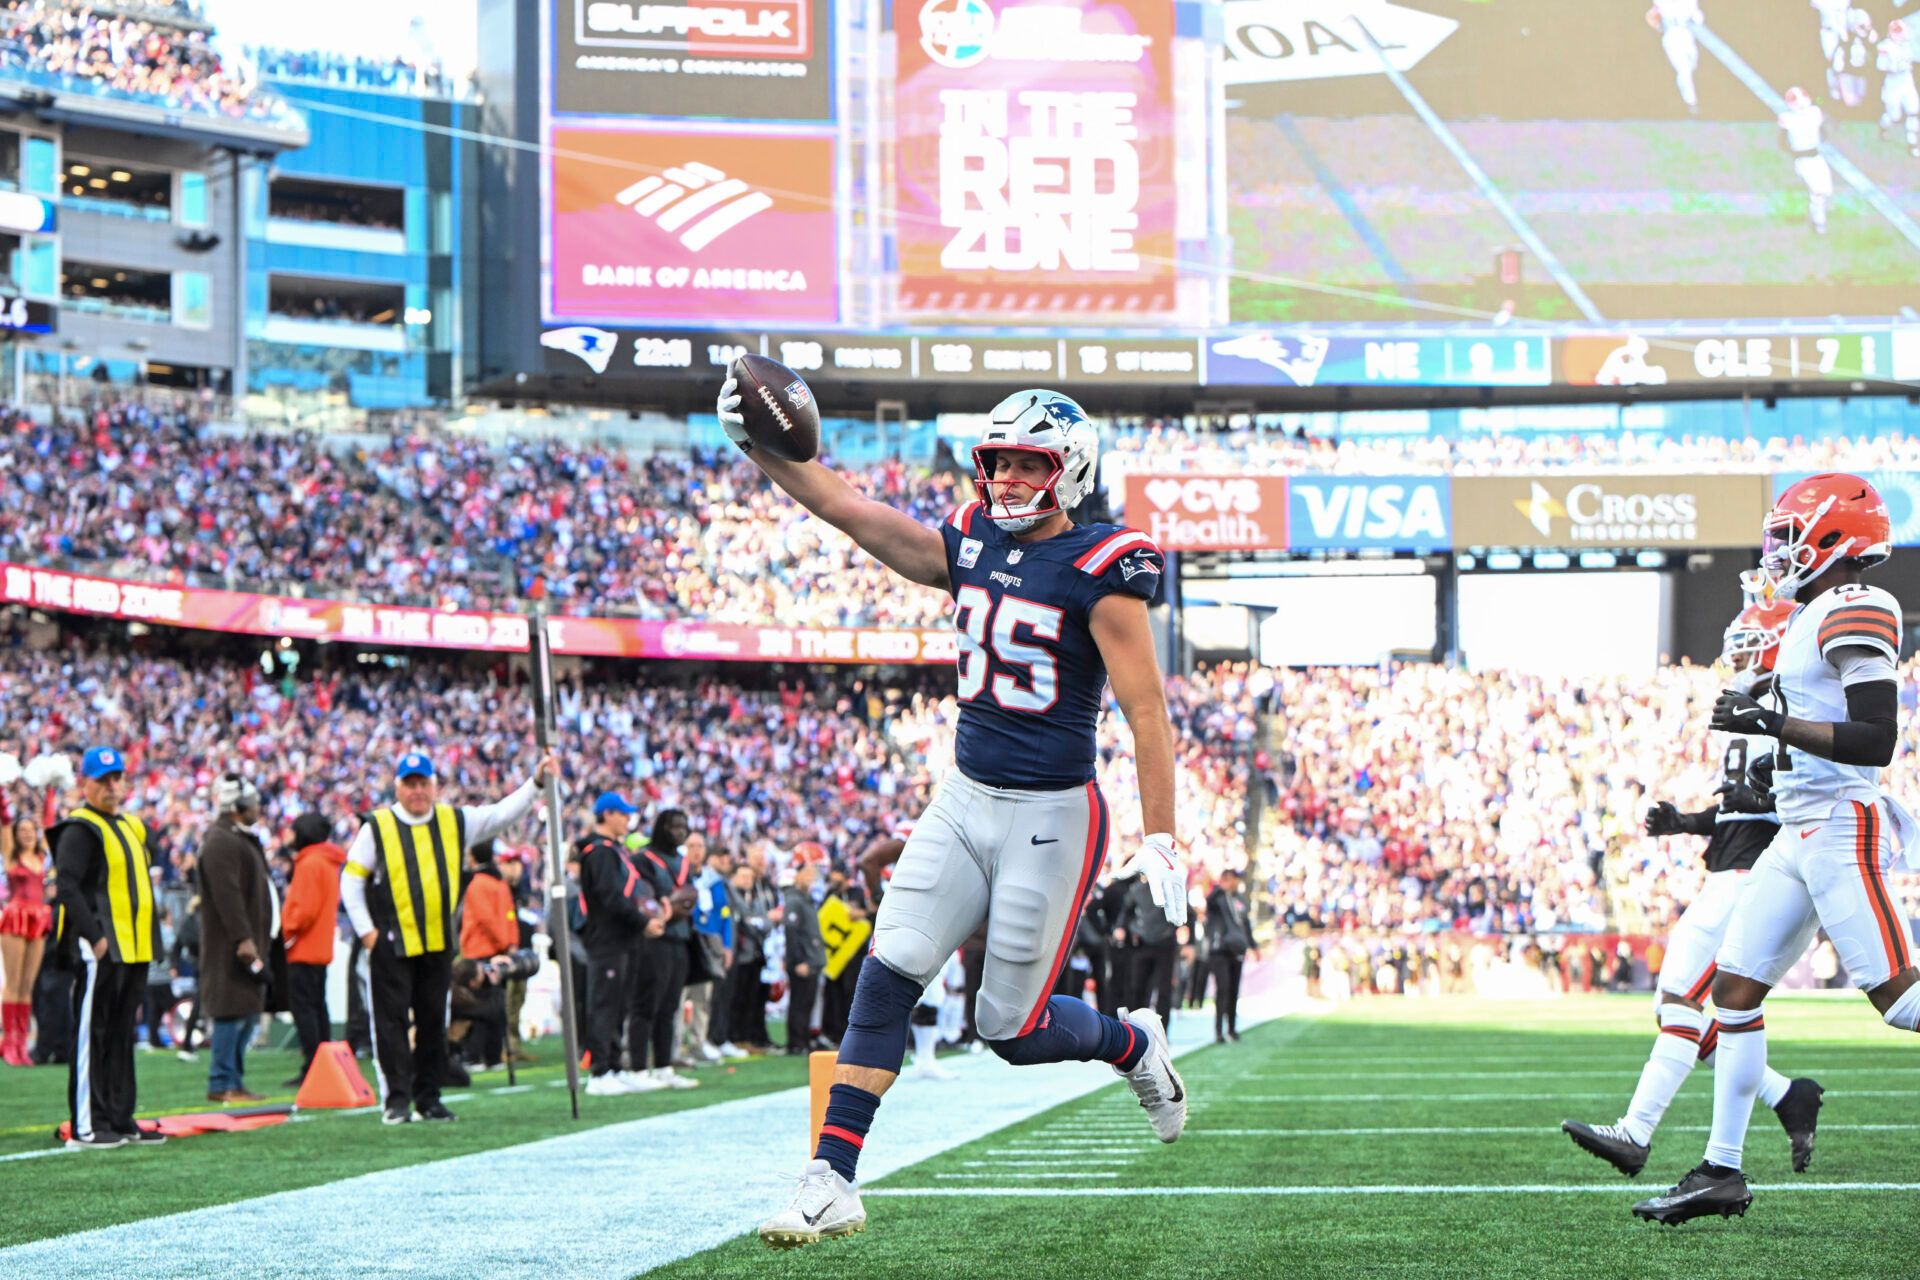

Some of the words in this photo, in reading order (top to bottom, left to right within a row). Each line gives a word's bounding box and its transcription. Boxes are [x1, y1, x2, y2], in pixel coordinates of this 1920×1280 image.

[1224, 15, 1407, 62] OAL
[940, 89, 1007, 138] IN
[1018, 91, 1138, 140] THE
[940, 137, 1140, 213] RED
[940, 210, 1141, 271] ZONE
[582, 264, 652, 286] BANK
[656, 266, 690, 288] OF
[693, 268, 808, 291] AMERICA
[1364, 341, 1420, 380] NE
[1816, 338, 1840, 374] 7
[1181, 479, 1262, 513] CVS
[1291, 484, 1447, 539] VISA
[1150, 512, 1261, 545] Health
[5, 566, 31, 600] IN
[33, 571, 73, 607] THE
[989, 570, 1022, 588] PATRIOTS
[342, 606, 373, 637] IN
[376, 610, 431, 641] THE
[490, 617, 565, 649] ZOE
[758, 629, 792, 657] IN
[795, 630, 853, 658] THE
[921, 632, 958, 660] ZO
[954, 584, 1065, 714] 85
